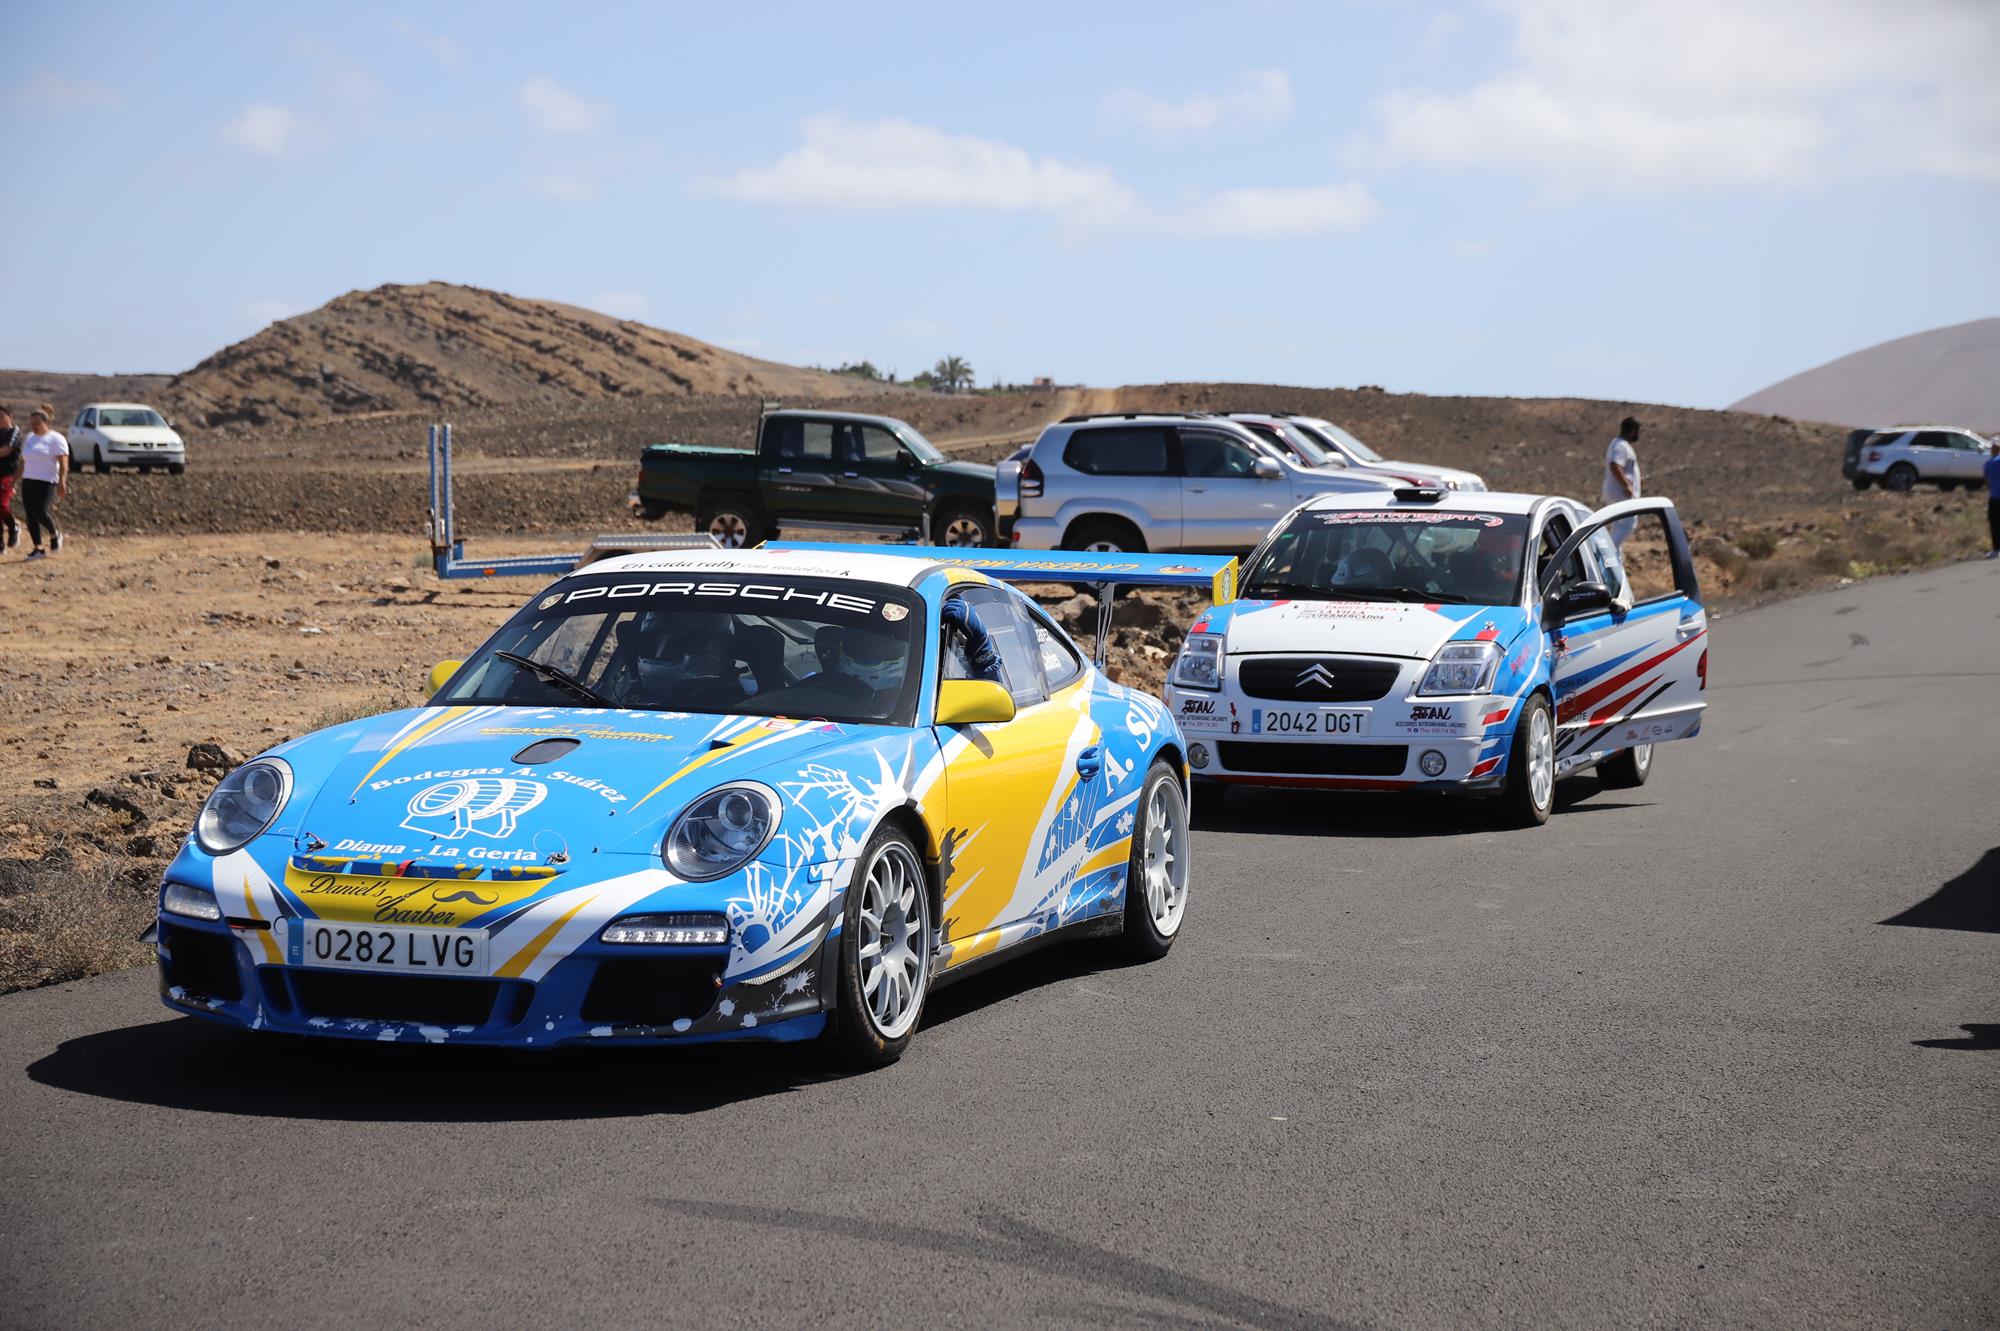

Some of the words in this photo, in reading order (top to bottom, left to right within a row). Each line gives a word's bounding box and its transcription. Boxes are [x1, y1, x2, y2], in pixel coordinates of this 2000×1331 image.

[620, 562, 643, 570] En
[648, 560, 691, 568] cada
[697, 559, 740, 570] rally
[1099, 563, 1141, 571] LA
[565, 582, 877, 615] PORSCHE
[1266, 711, 1317, 733] 2042
[1325, 713, 1364, 733] DGT
[369, 766, 505, 791] Bodegas
[511, 766, 537, 778] A.
[546, 768, 630, 803] Suárez
[429, 844, 459, 858] La
[467, 845, 537, 861] Geria
[301, 875, 390, 897] Daniel's
[315, 927, 396, 965] 0282
[408, 932, 475, 968] LVG
